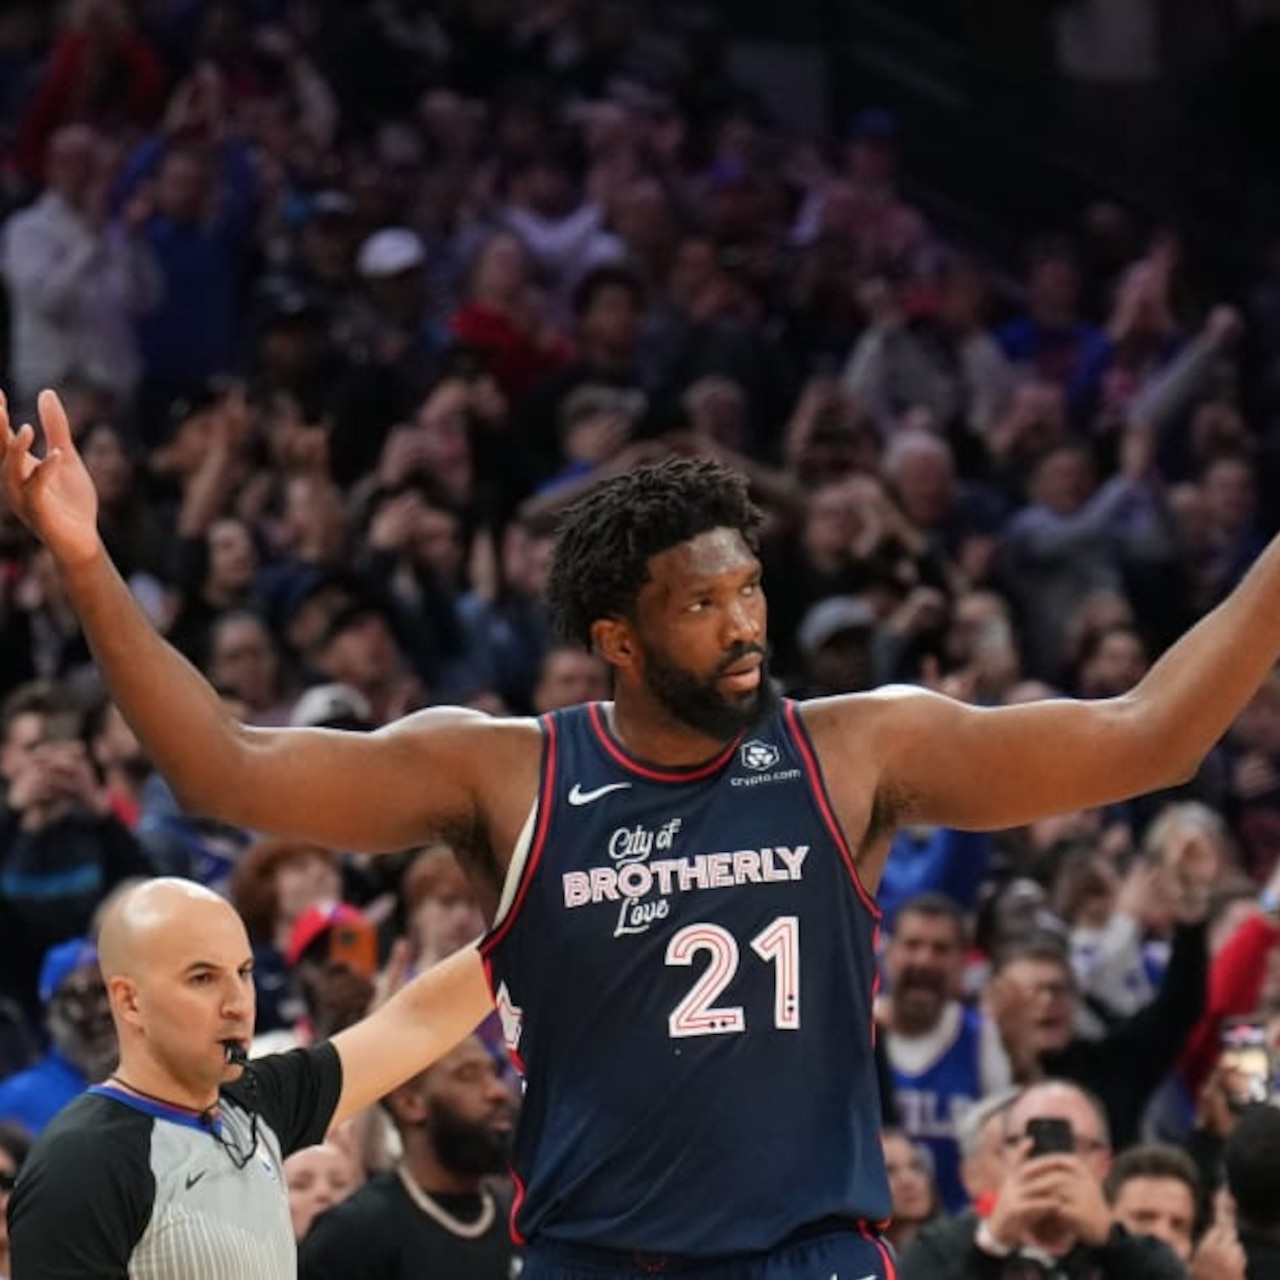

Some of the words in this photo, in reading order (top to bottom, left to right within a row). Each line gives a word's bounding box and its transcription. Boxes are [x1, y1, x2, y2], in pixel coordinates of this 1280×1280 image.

[730, 767, 801, 787] crypto.com
[609, 825, 655, 868] City
[655, 817, 683, 849] of
[562, 846, 810, 907] BROTHERLY
[613, 897, 670, 938] Love
[664, 915, 801, 1038] 21
